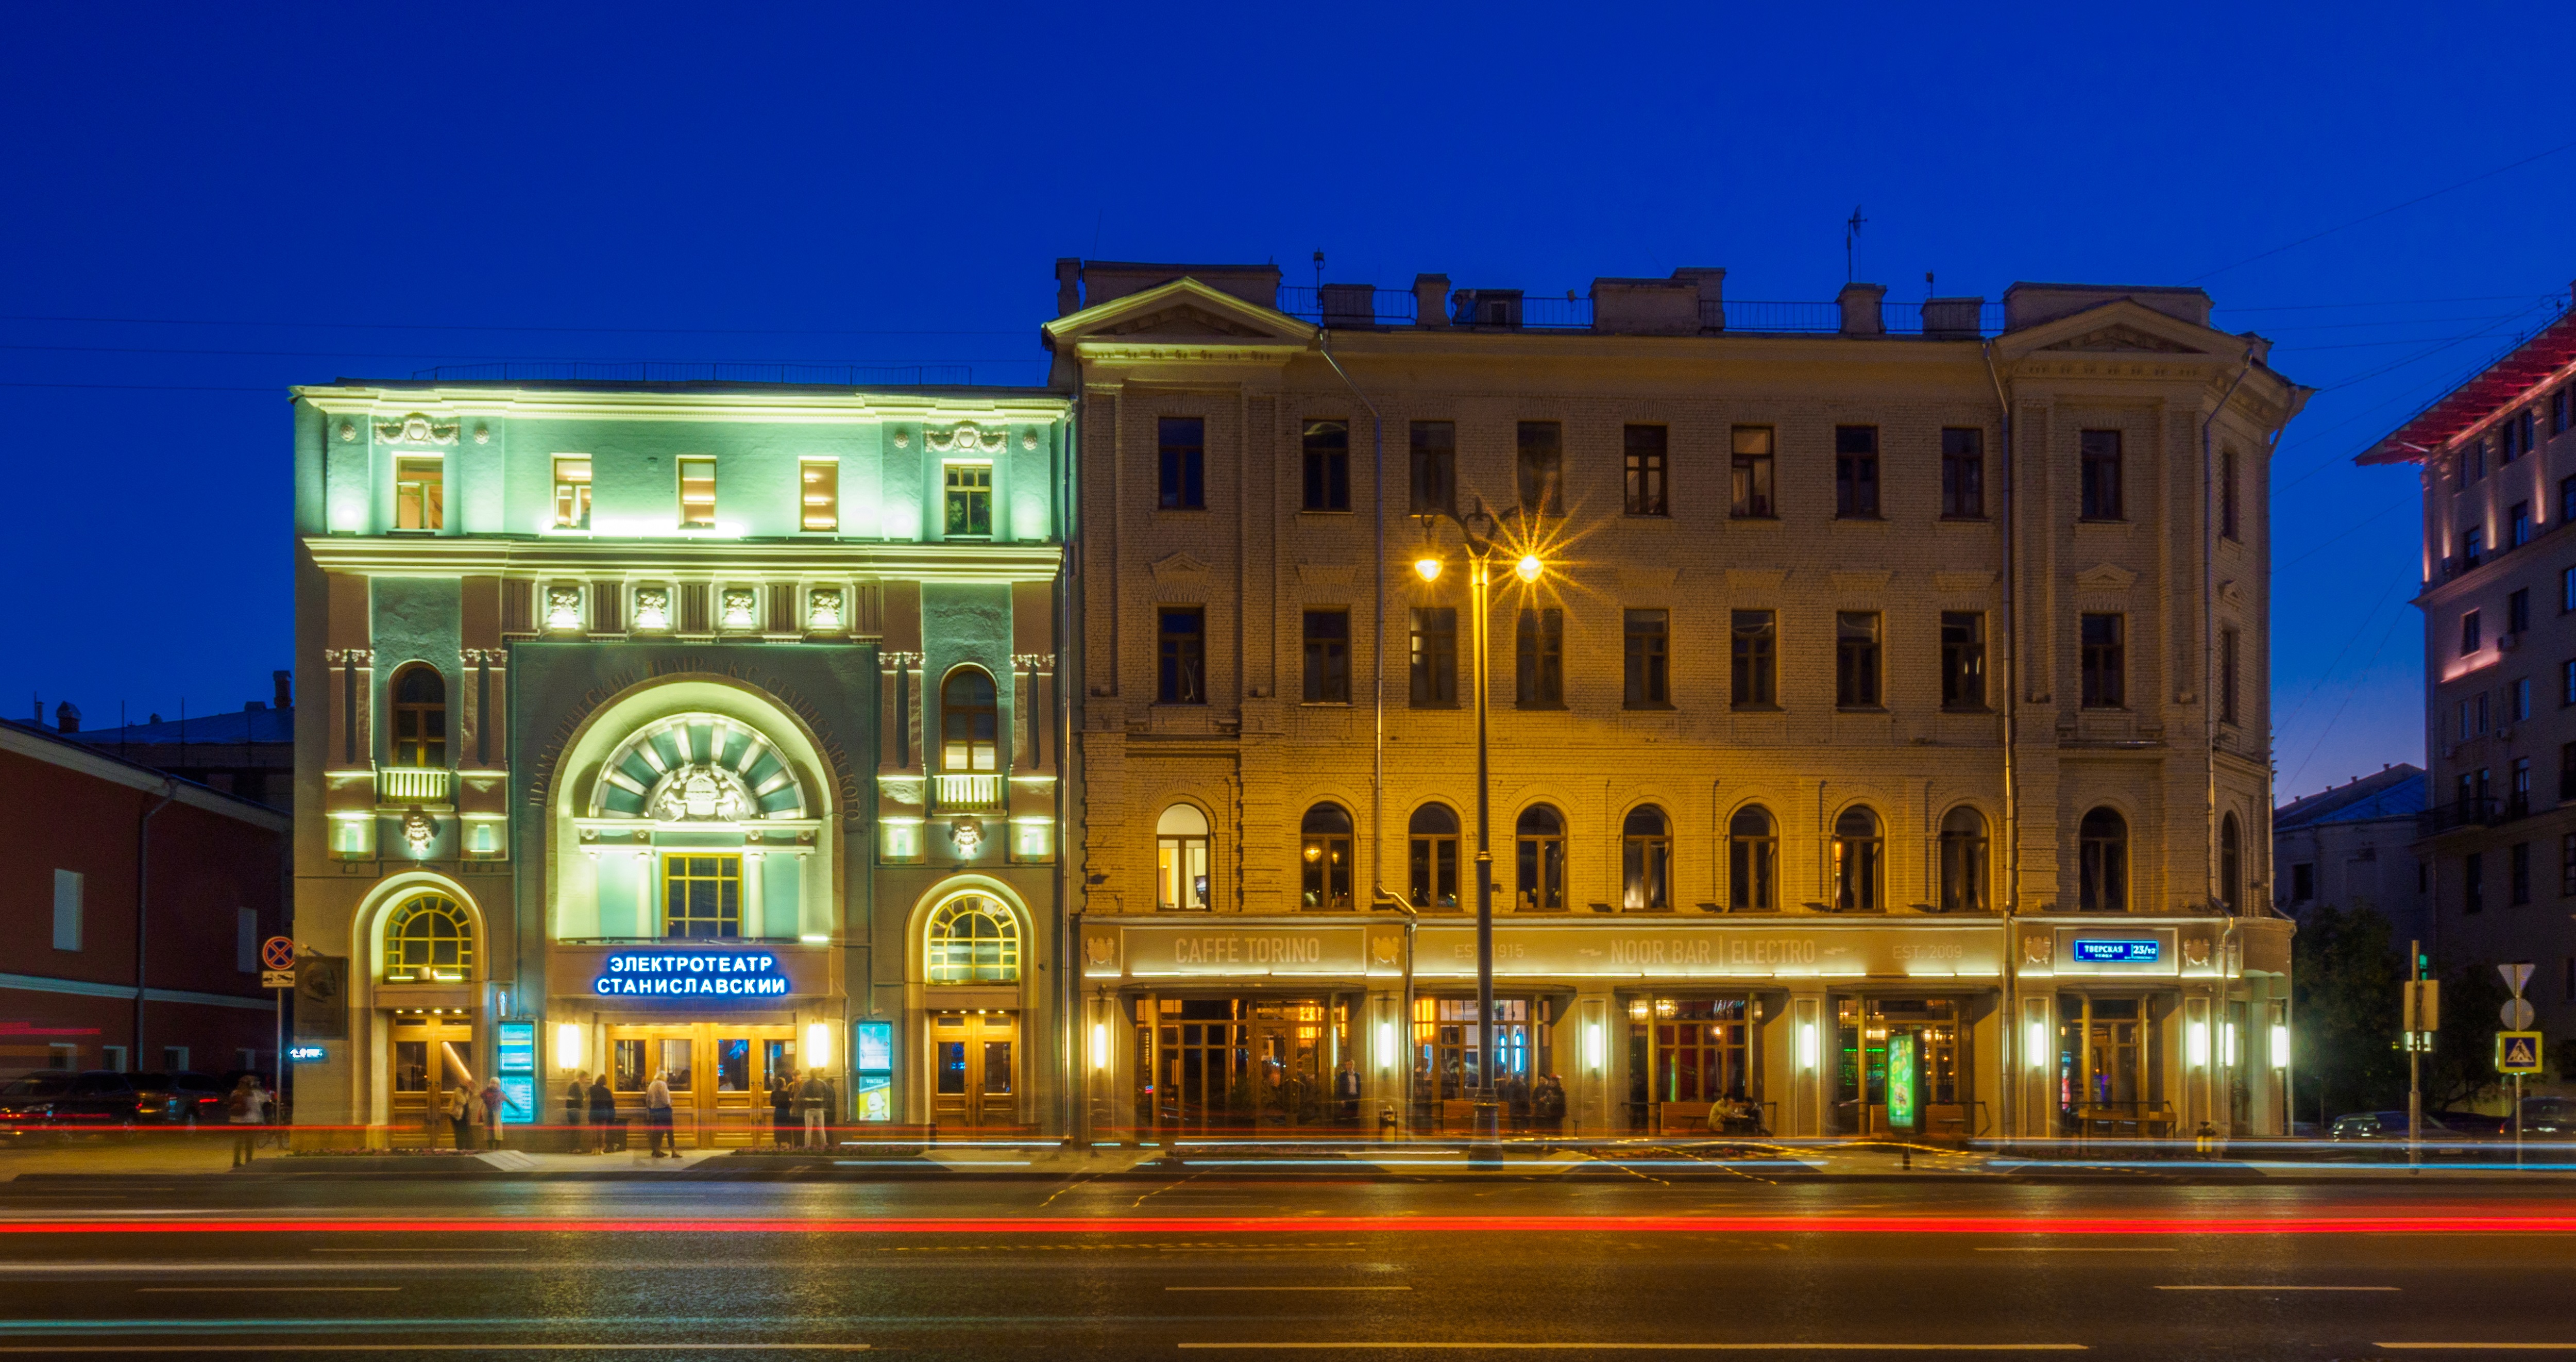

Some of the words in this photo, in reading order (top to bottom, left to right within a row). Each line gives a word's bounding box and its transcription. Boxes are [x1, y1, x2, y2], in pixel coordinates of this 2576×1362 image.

[1245, 937, 1319, 963] TORINO
[1611, 939, 1665, 964] NOOR
[1672, 939, 1711, 964] BAR
[1731, 939, 1815, 964] ELECTRO
[1928, 945, 1962, 959] 2009
[611, 957, 772, 972] ЭЛЕКТРОТЕАТР
